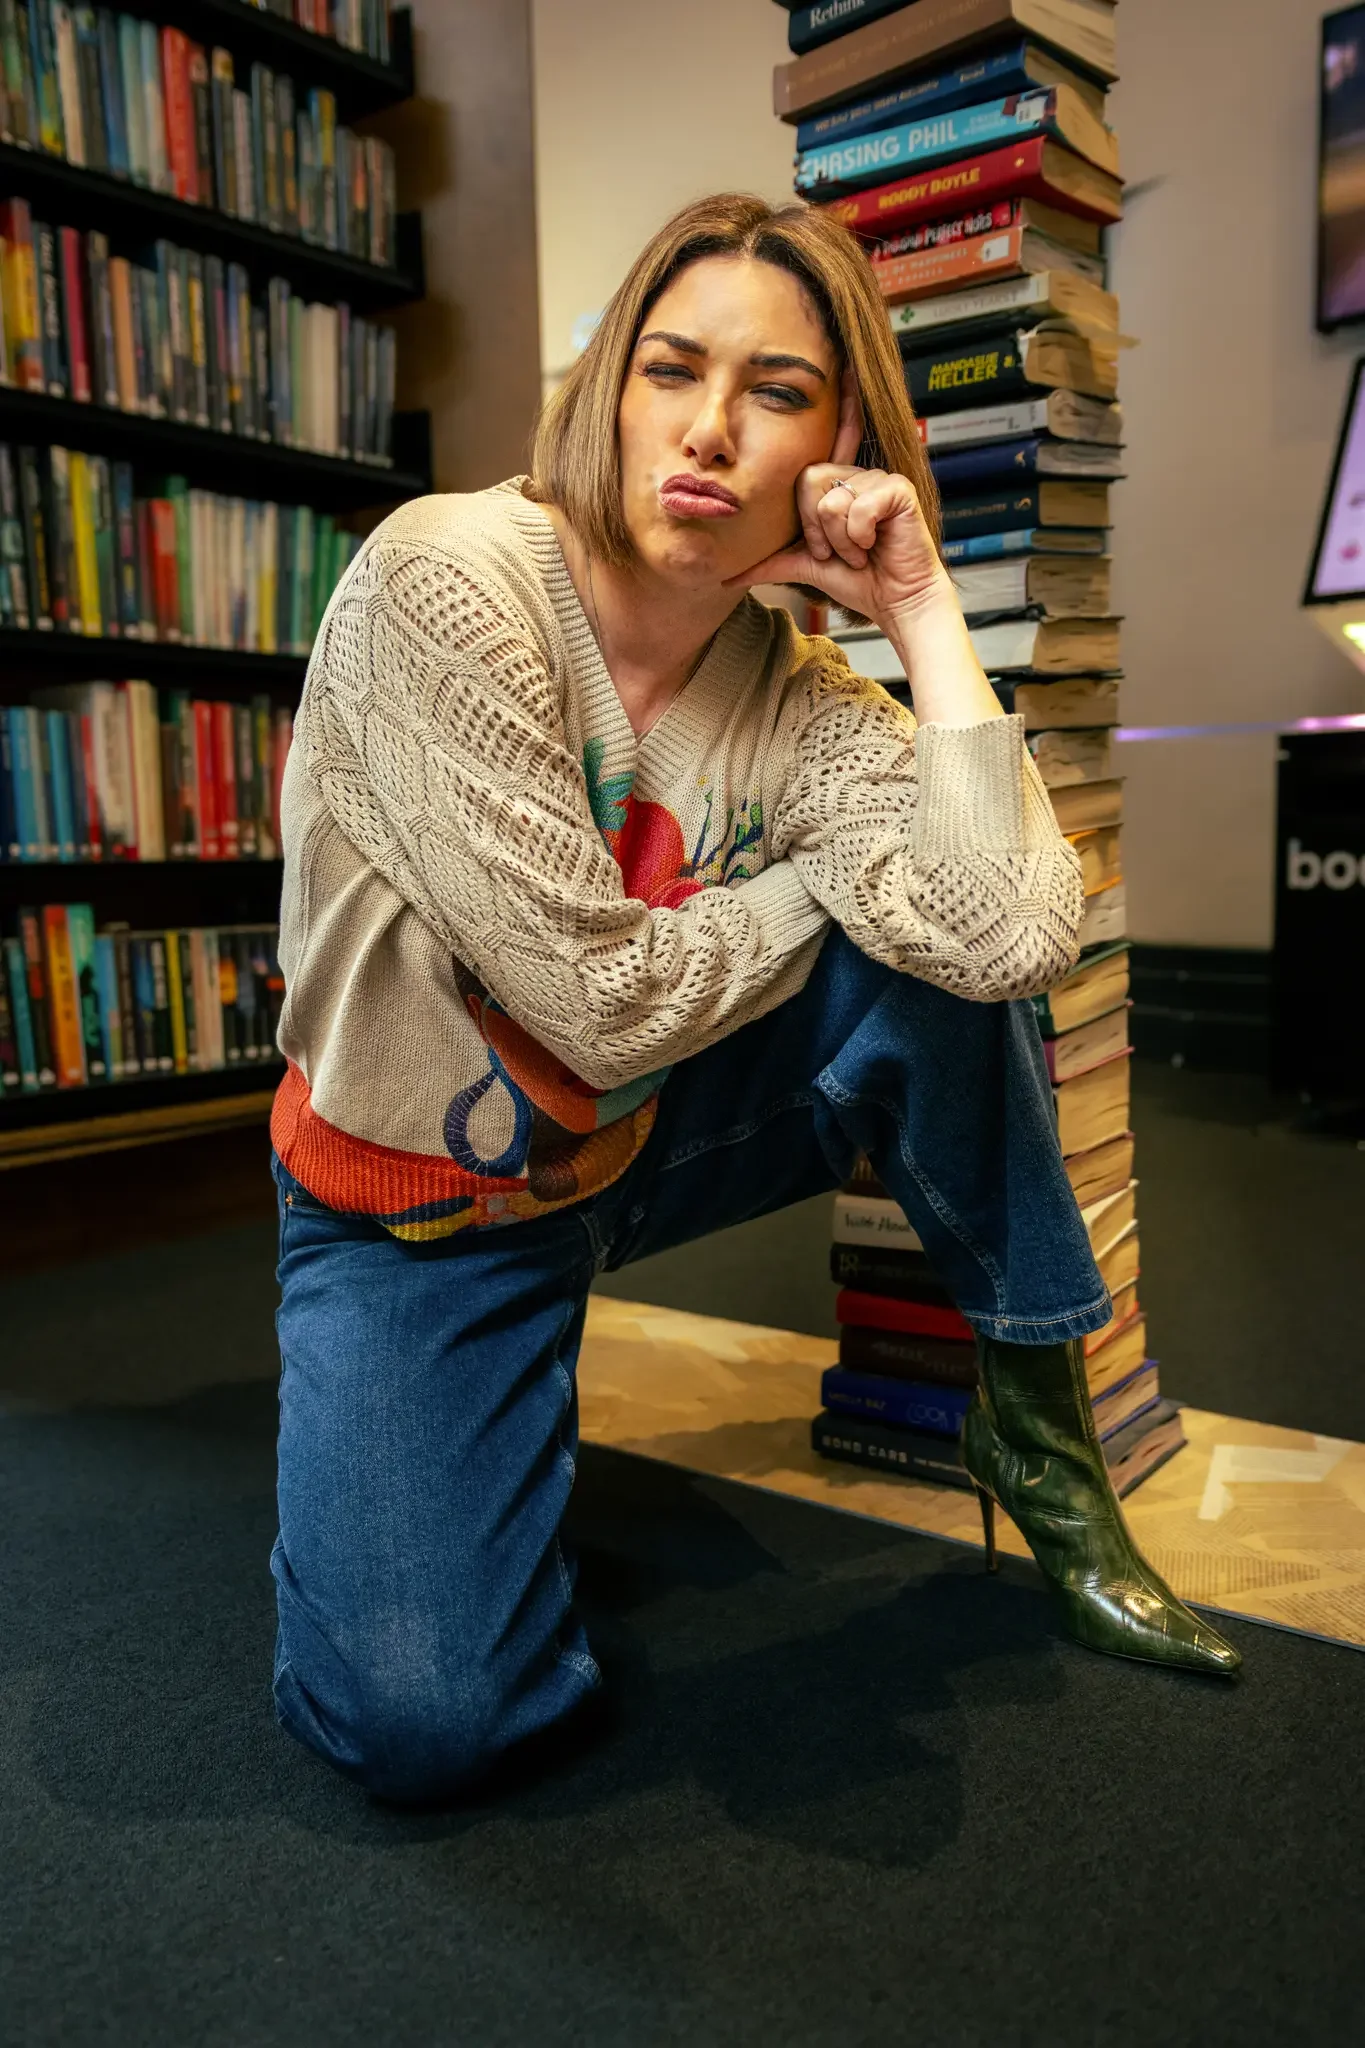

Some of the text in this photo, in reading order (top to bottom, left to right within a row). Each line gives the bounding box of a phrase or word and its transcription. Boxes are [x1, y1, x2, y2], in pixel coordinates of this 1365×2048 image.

[800, 135, 900, 185] CHASING
[908, 119, 958, 152] PHIL
[878, 167, 981, 209] RODDY DOYLE
[924, 220, 963, 246] PERFECT
[964, 211, 992, 233] NOTES
[928, 363, 998, 391] HELLER
[1287, 837, 1365, 891] bo
[868, 1444, 908, 1464] CARS
